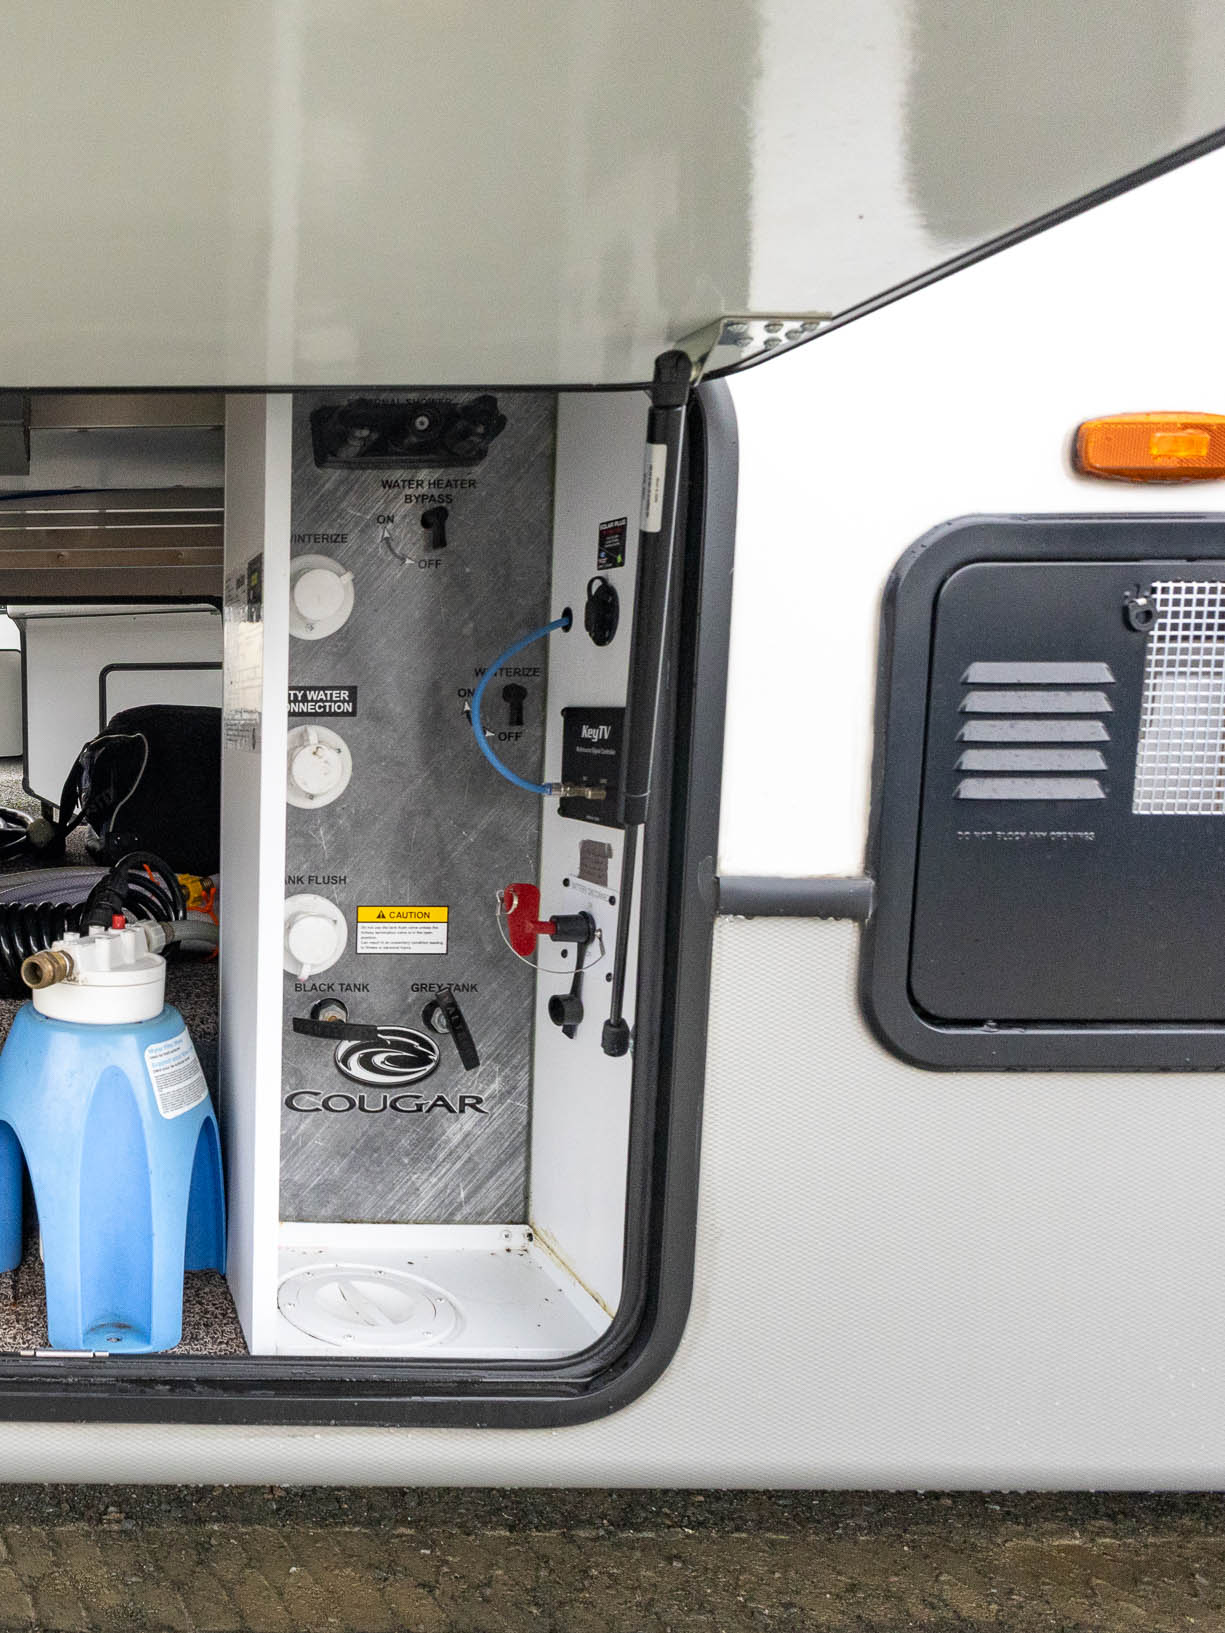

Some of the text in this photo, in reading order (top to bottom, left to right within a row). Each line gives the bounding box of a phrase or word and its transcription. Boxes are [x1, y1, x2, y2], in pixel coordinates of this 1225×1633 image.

[381, 479, 477, 490] WATER HEATER
[404, 494, 453, 504] BYPASS
[376, 515, 395, 525] ON
[291, 533, 349, 544] INTERIZE
[417, 559, 442, 569] OFF
[474, 667, 541, 677] WTERIZE
[288, 690, 349, 701] TY WATER
[457, 688, 475, 698] ON
[286, 702, 353, 713] NNECTION
[498, 732, 522, 742] OFF
[581, 725, 612, 742] KeyTV
[285, 875, 347, 885] NK FLUSH
[389, 911, 430, 919] CAUTION
[294, 983, 370, 993] BLACK TANK
[411, 983, 478, 993] GREY TANK
[284, 1090, 489, 1114] COUGAR
